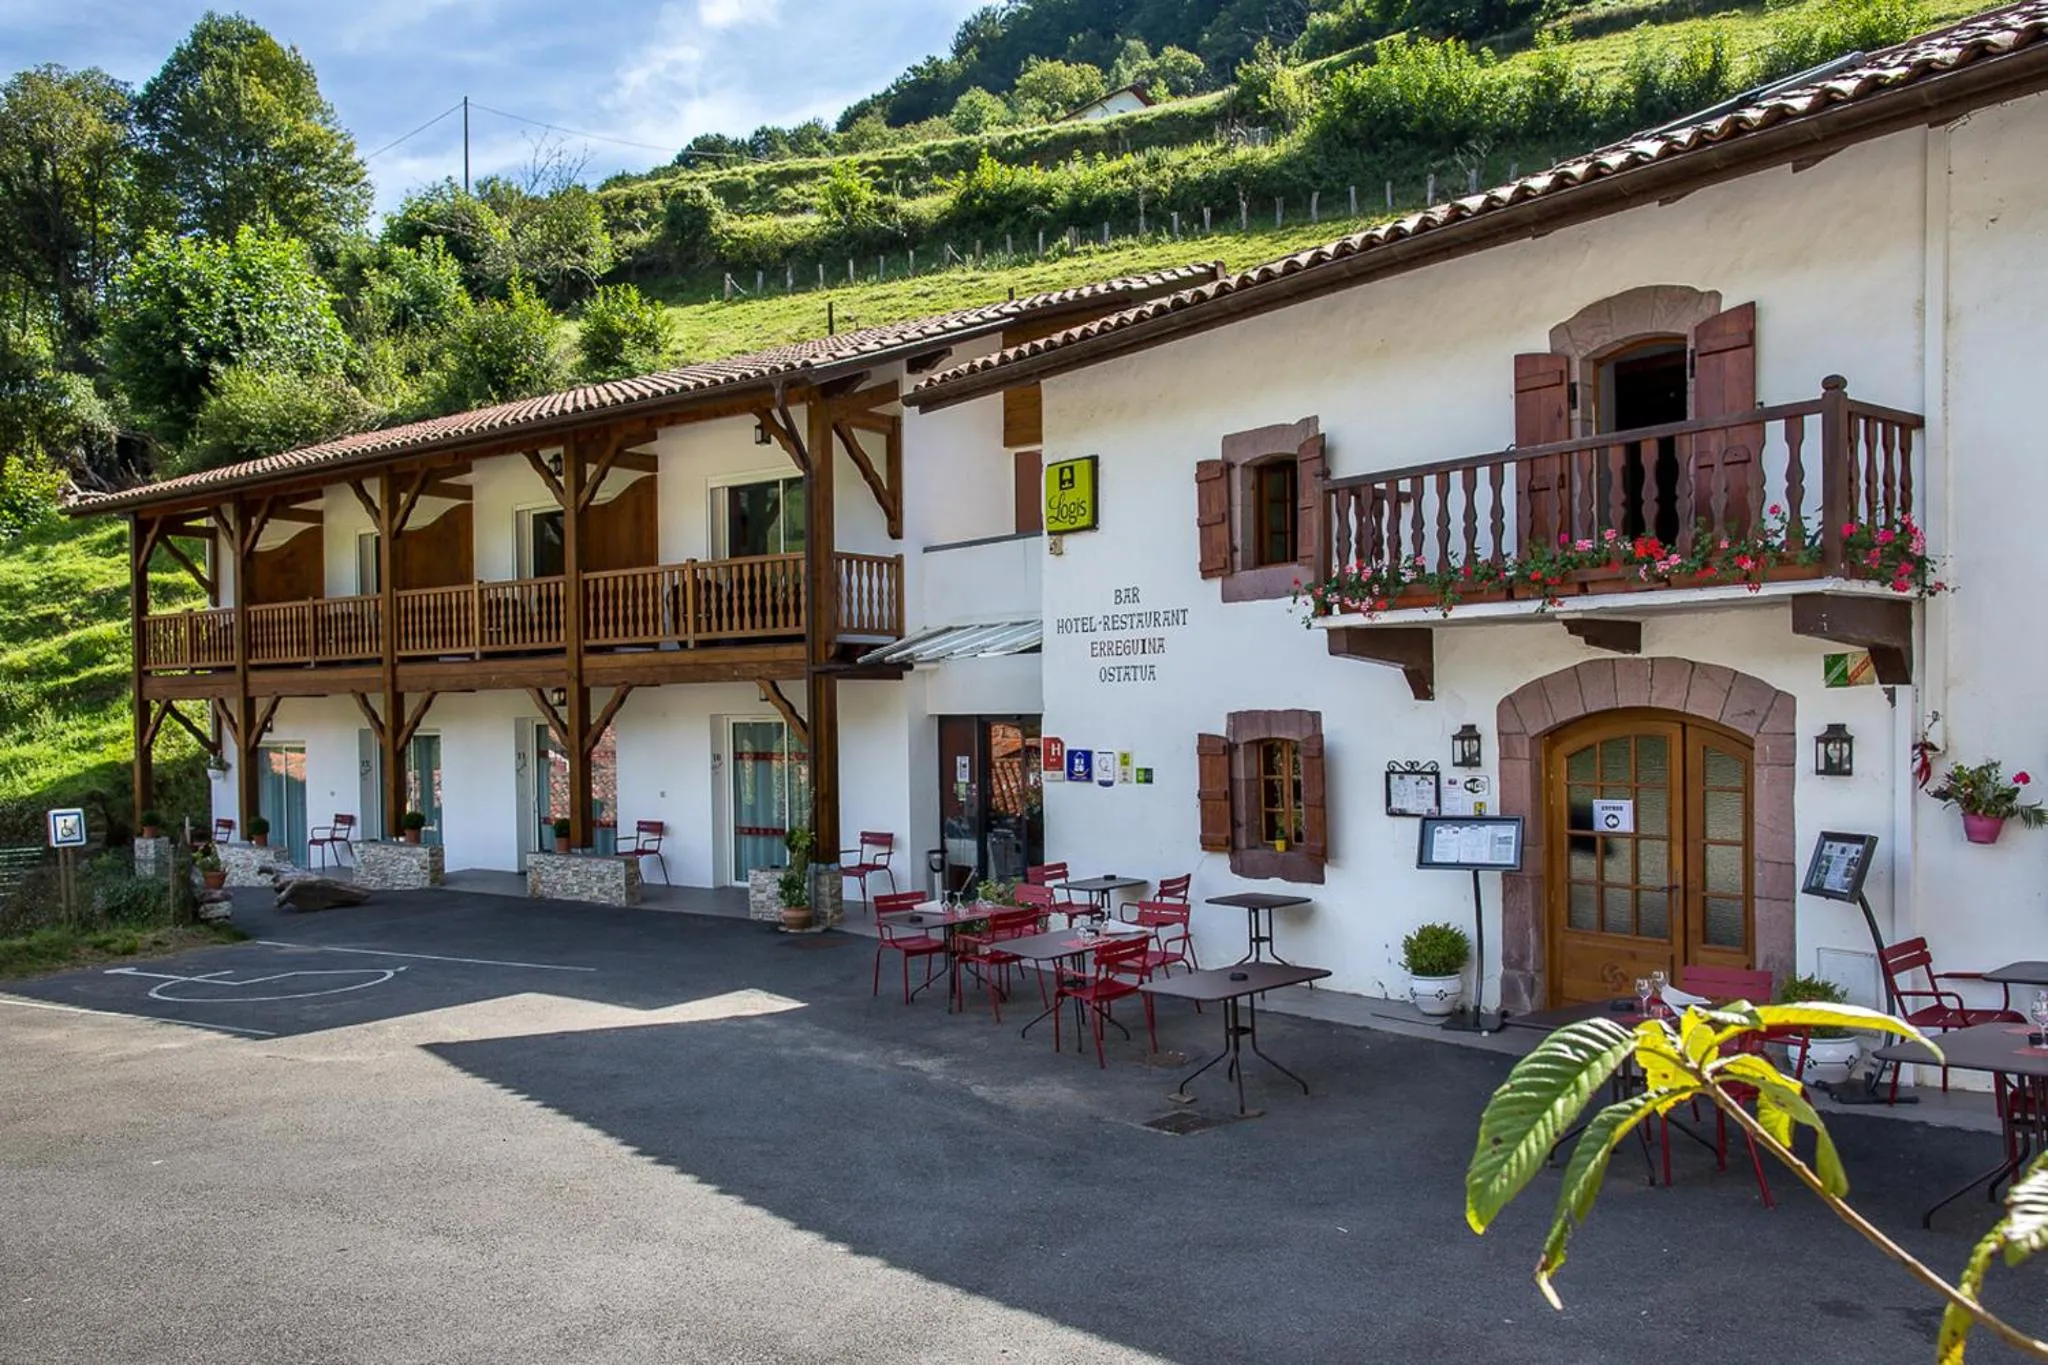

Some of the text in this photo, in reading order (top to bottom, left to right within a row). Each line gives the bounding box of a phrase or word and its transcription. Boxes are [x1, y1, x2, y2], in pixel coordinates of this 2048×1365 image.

[1047, 493, 1087, 525] Logis
[1114, 586, 1140, 605] BAR
[1057, 609, 1189, 634] HOTEL-RESTAURANT
[1091, 637, 1166, 658] ERREGUINA
[1099, 664, 1157, 683] OSTATUA
[1051, 743, 1061, 756] H
